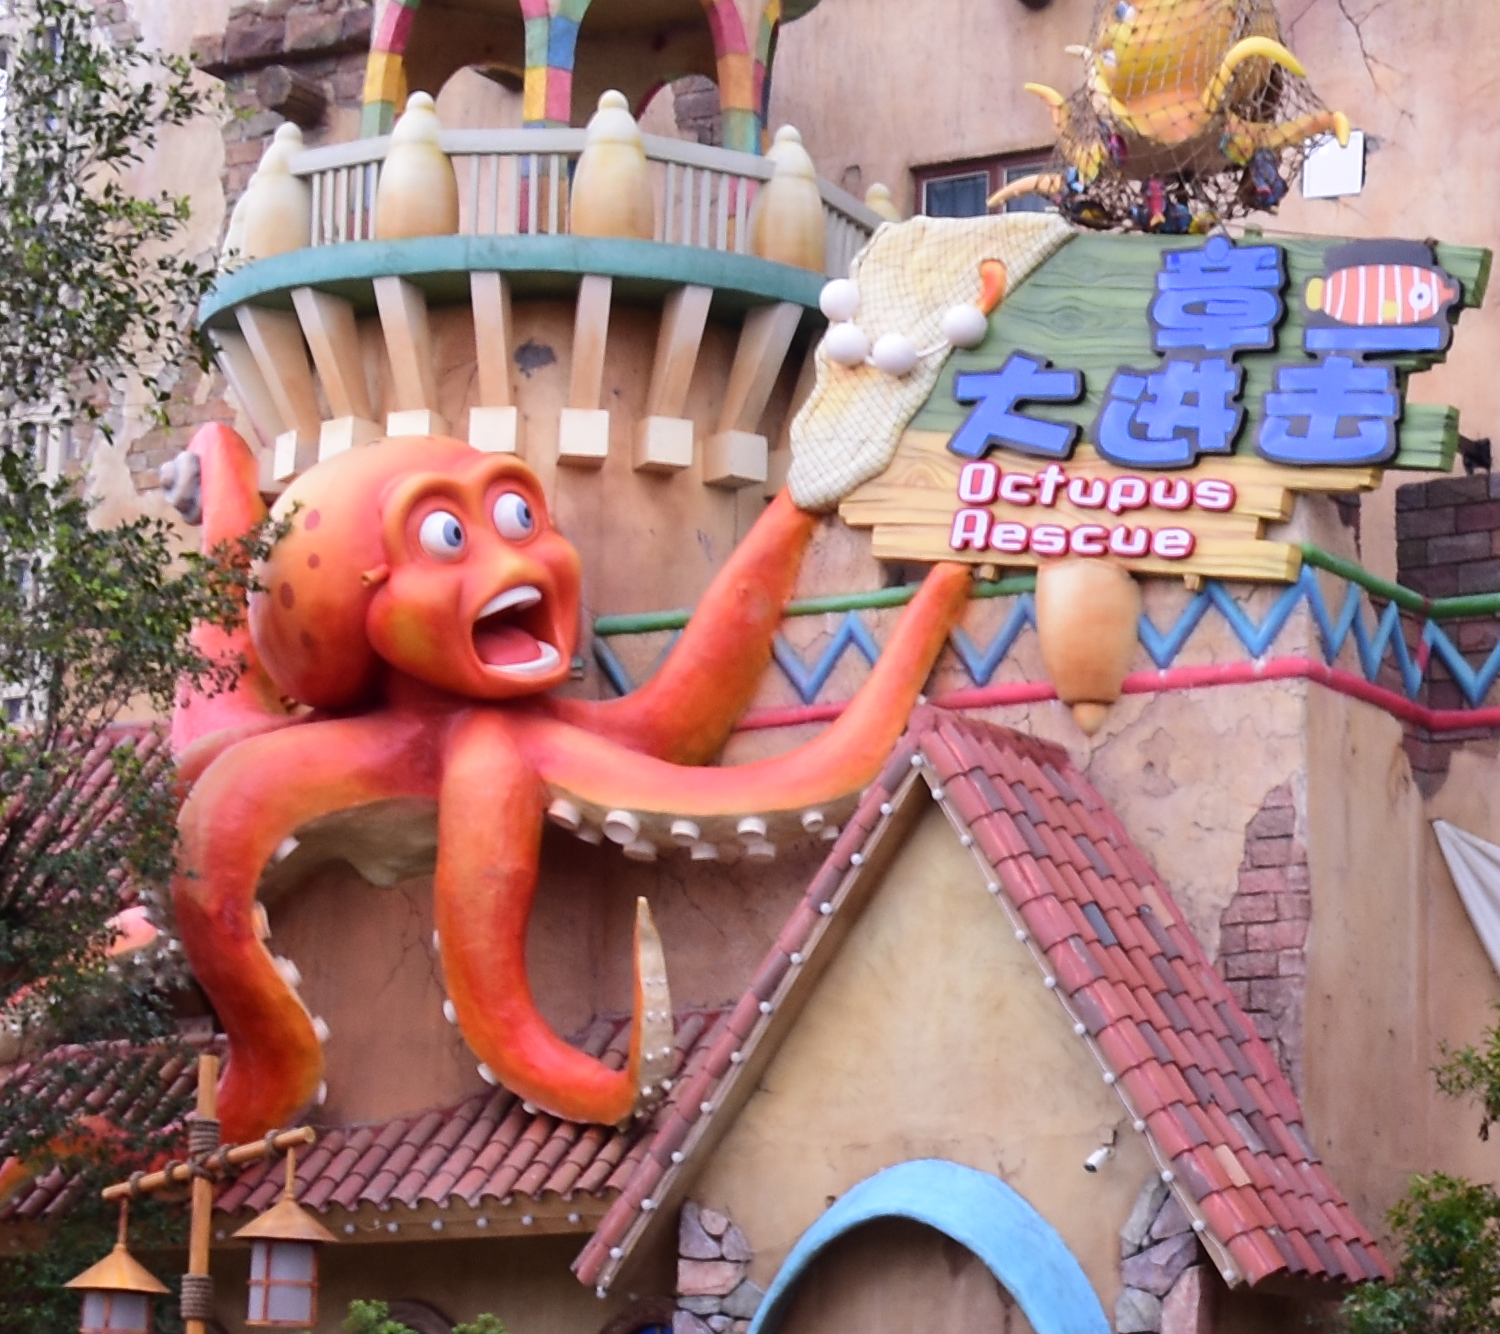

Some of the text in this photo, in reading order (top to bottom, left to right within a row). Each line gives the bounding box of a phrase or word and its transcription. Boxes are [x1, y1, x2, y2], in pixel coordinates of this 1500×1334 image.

[950, 356, 1396, 463] 大进击
[957, 460, 1236, 514] Octupus
